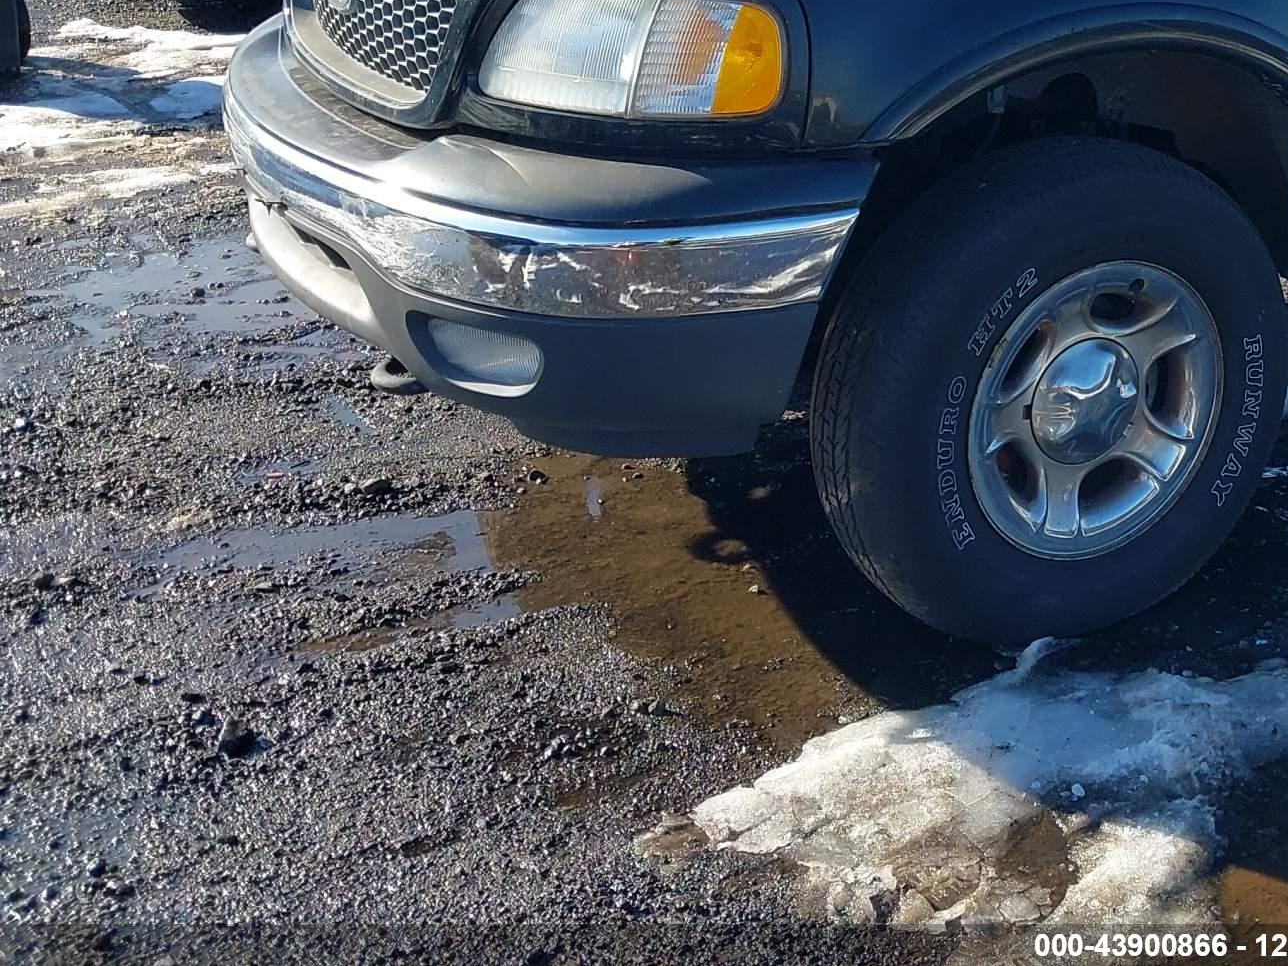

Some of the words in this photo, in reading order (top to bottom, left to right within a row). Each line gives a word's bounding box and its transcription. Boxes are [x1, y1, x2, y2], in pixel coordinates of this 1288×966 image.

[937, 376, 976, 551] ENDURO
[967, 267, 1038, 357] HT2
[1211, 334, 1264, 507] RUNWAY
